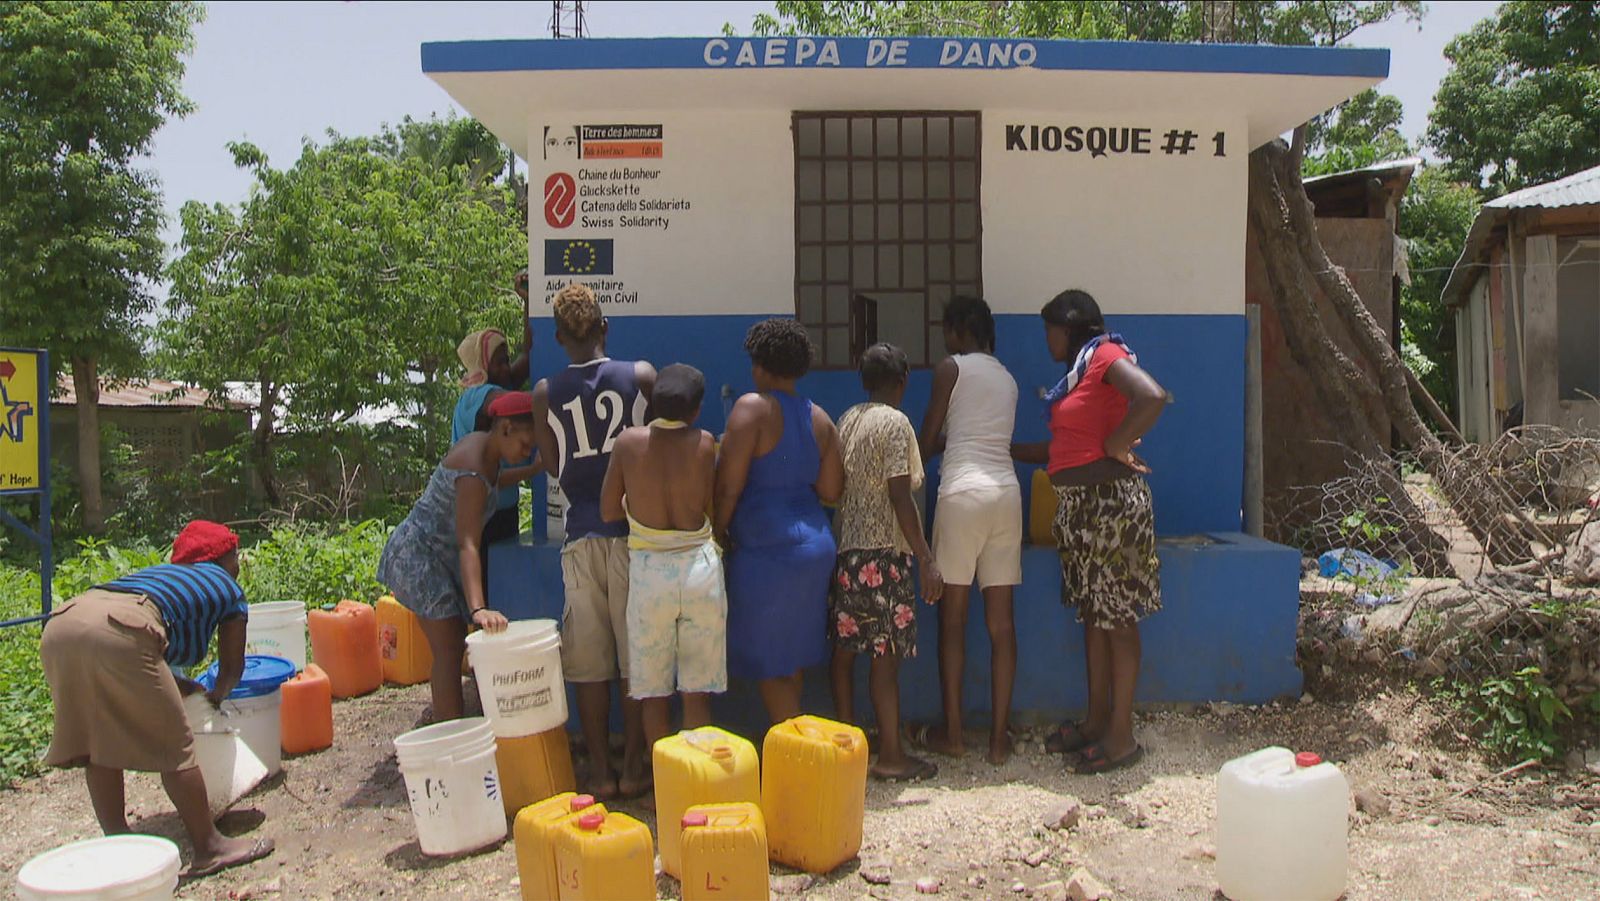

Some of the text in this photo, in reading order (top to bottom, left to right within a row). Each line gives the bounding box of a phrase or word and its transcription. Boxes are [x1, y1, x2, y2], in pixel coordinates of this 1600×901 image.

[703, 38, 1037, 67] CAEPA DE DANO
[584, 126, 659, 138] Terre des hommes
[1005, 124, 1227, 159] KIOSQUE # 1
[578, 167, 661, 181] Chaine du Bonheur
[581, 200, 615, 213] Catena
[616, 199, 637, 212] della
[581, 215, 669, 231] Swiss Solidarity
[546, 279, 565, 291] Aide
[614, 292, 638, 304] Civil
[10, 473, 32, 487] Hope
